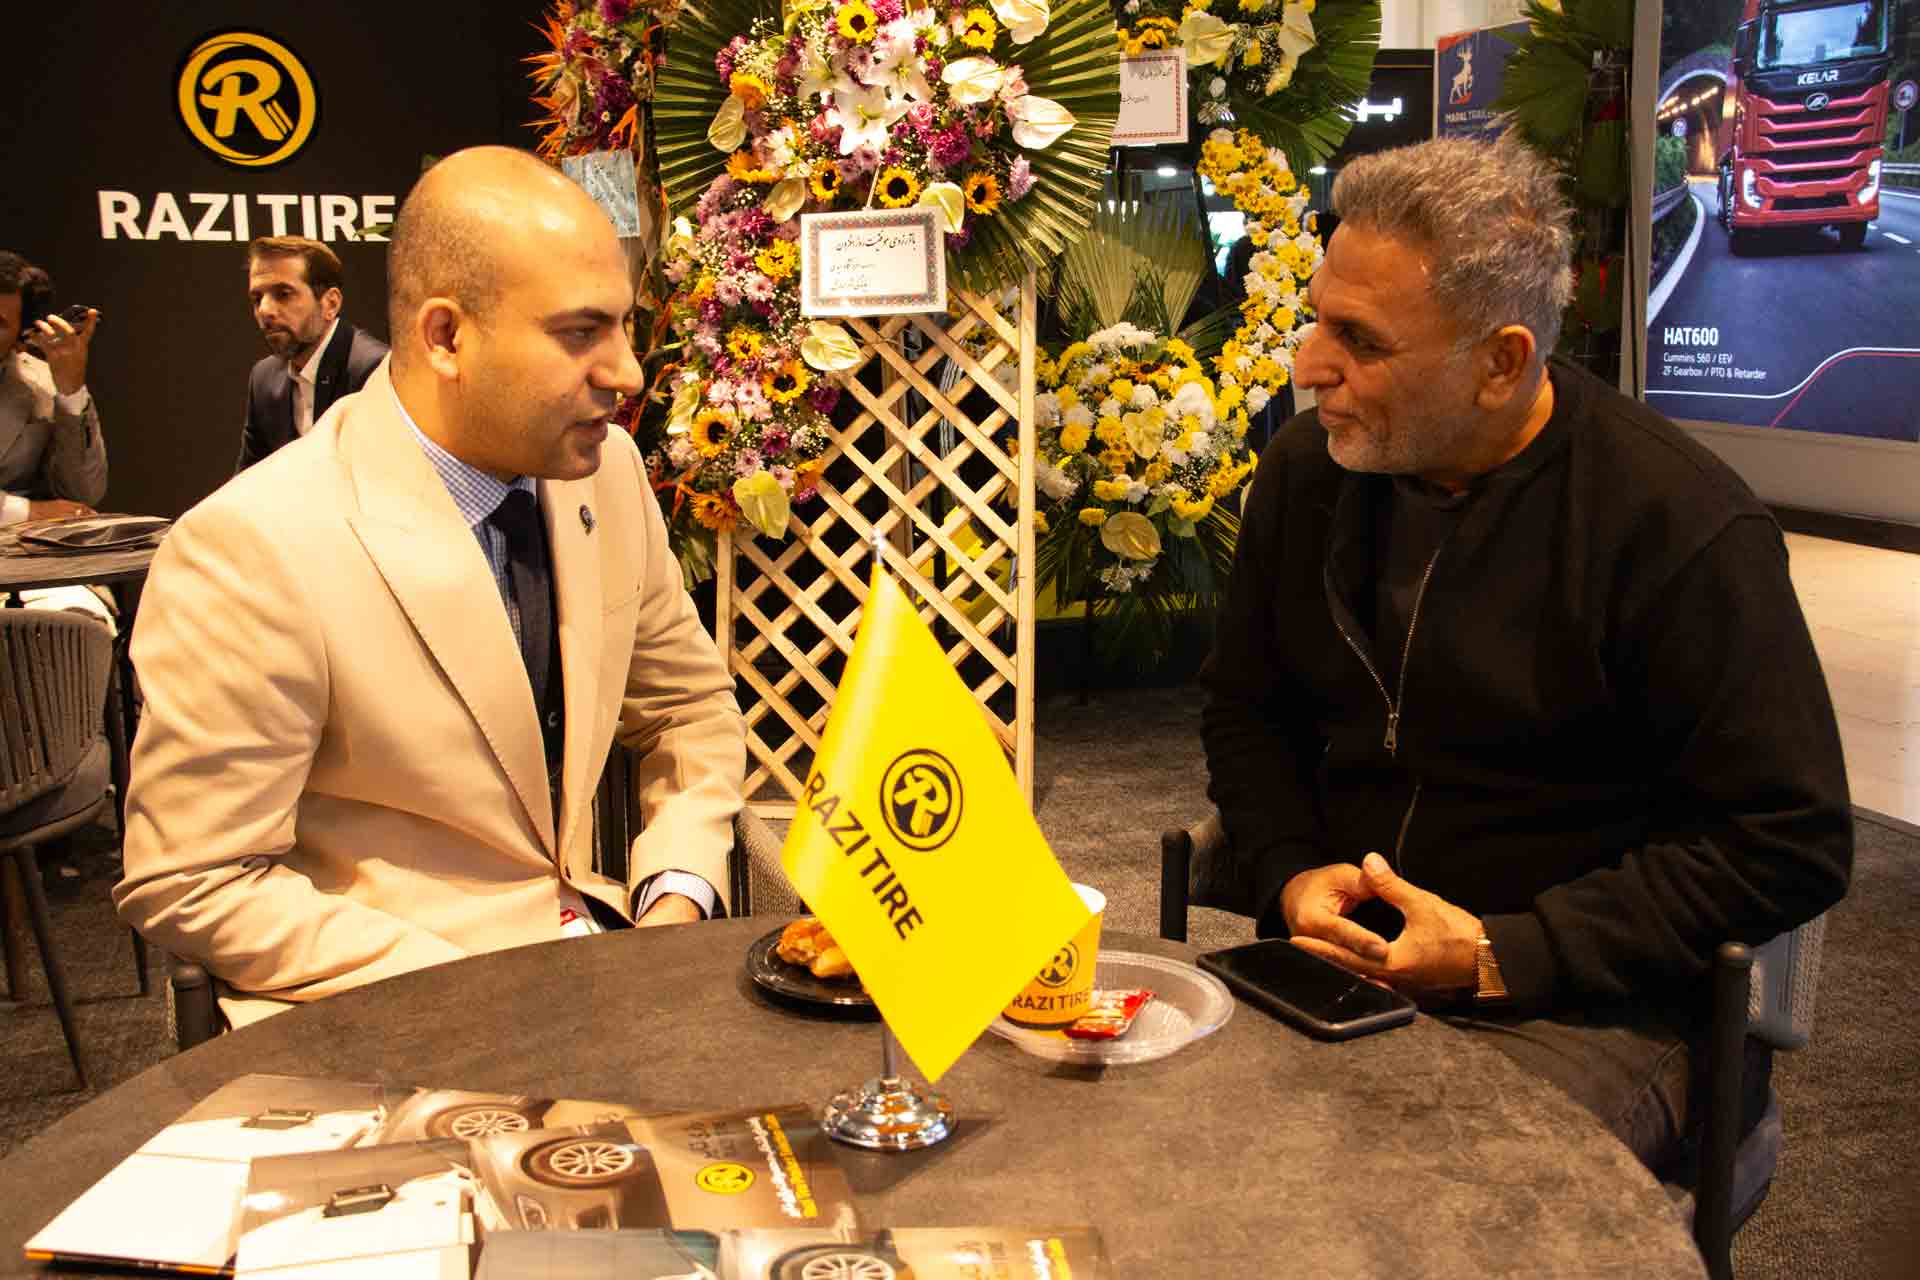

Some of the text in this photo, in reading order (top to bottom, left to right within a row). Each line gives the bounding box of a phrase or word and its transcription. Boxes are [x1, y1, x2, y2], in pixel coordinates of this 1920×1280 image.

[1797, 69, 1839, 86] KELAR
[97, 190, 396, 242] RAZI TIRE
[1664, 327, 1719, 346] HAT600
[1663, 352, 1695, 363] Cummins
[1673, 366, 1703, 377] Gearbox
[803, 770, 925, 941] RAZI TIRE
[1011, 993, 1054, 1011] RAZI
